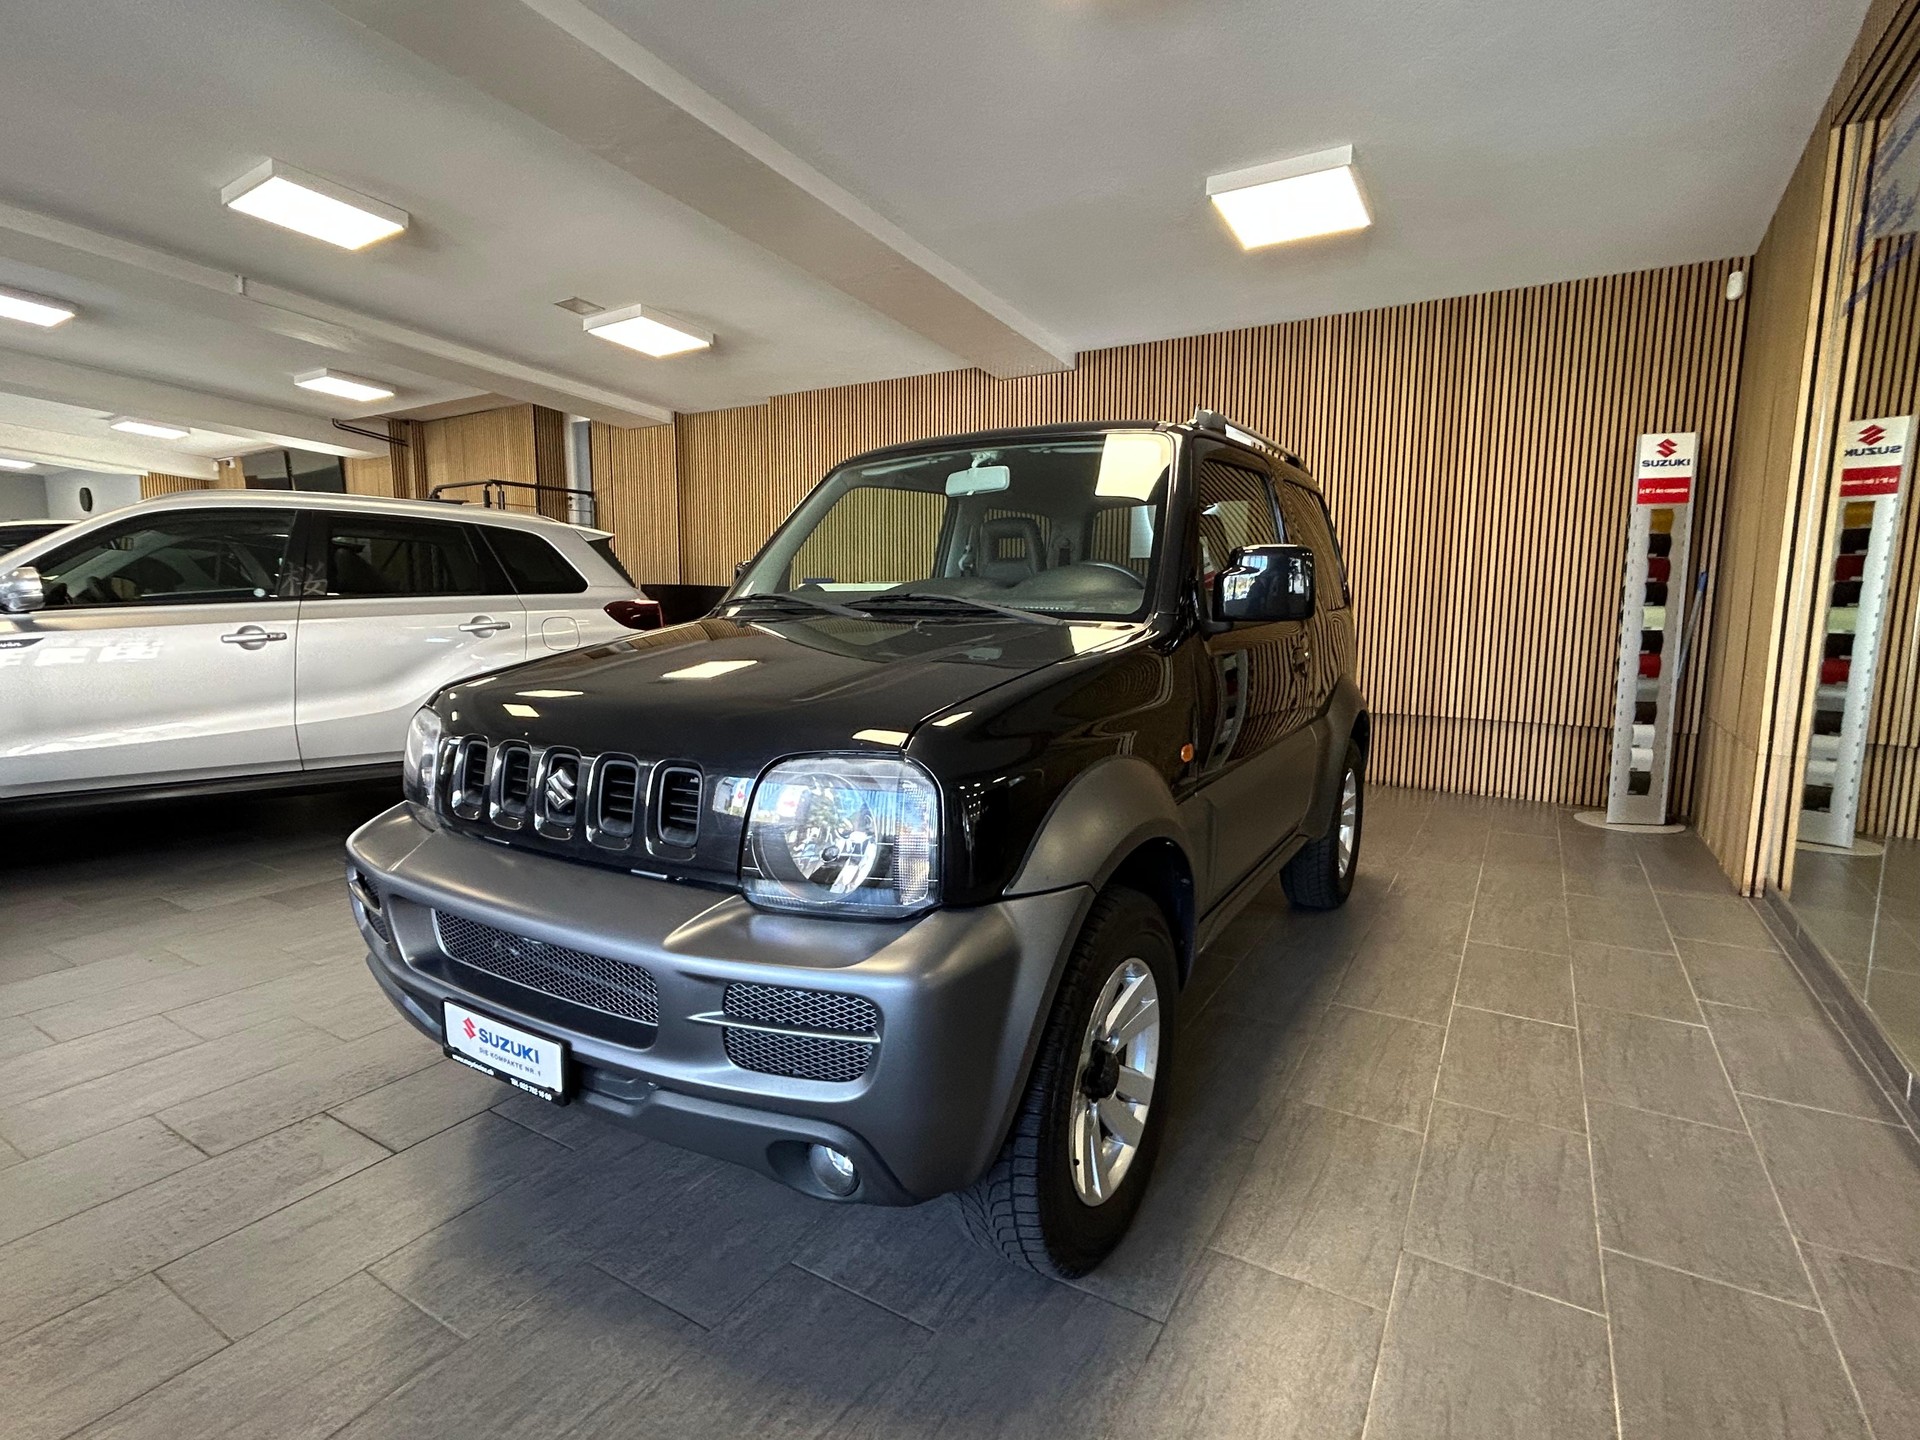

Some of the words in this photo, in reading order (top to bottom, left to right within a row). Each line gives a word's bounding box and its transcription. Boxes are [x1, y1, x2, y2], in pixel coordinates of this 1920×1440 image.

[1642, 459, 1690, 467] SUZUKI
[478, 1028, 540, 1064] SUZUKI
[490, 1052, 523, 1071] KOMPAKTE
